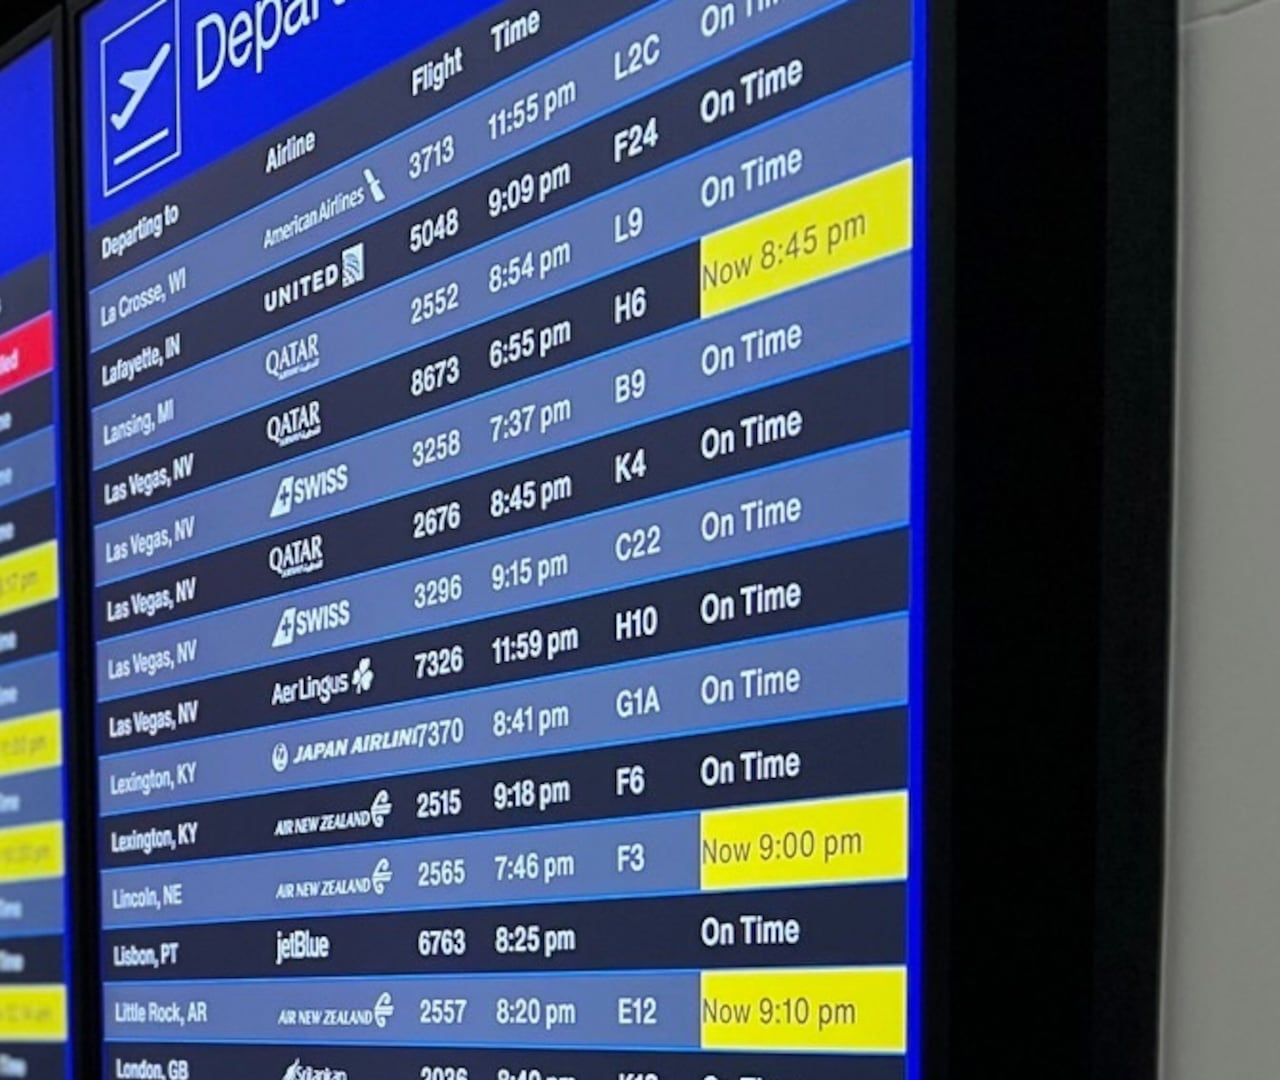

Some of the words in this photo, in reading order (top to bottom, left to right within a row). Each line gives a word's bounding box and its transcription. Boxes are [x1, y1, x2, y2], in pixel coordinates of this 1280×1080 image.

[489, 9, 541, 53] Time
[700, 2, 736, 39] On
[411, 45, 464, 98] Flight
[613, 32, 661, 82] L2C
[487, 91, 540, 141] 11:55
[543, 80, 577, 122] pm
[699, 88, 736, 124] On
[739, 58, 804, 106] Time
[264, 130, 317, 174] Airline
[408, 134, 455, 180] 3713
[613, 116, 659, 164] F24
[487, 172, 535, 218] 9:09
[538, 162, 572, 204] pm
[100, 212, 164, 261] Departing
[163, 203, 180, 227] to
[409, 206, 460, 253] 5048
[701, 254, 754, 292] Now
[759, 223, 819, 271] 8:45
[827, 213, 866, 256] pm
[100, 305, 118, 328] La
[117, 282, 167, 319] Crosse,
[167, 266, 187, 295] WI
[263, 262, 340, 313] UNITED
[614, 285, 647, 325] H6
[100, 345, 165, 388] Lafayette,
[164, 331, 182, 360] IN
[488, 327, 536, 369] 6:55
[539, 319, 572, 359] pm
[700, 343, 735, 377] On
[739, 323, 803, 363] Time
[410, 354, 461, 397] 8673
[614, 367, 646, 404] B9
[265, 399, 321, 439] QATAR
[489, 403, 537, 443] 7:37
[539, 398, 572, 435] pm
[411, 428, 461, 468] 3258
[103, 481, 129, 506] Las
[127, 466, 173, 498] Vegas,
[172, 451, 195, 482] NV
[293, 463, 349, 505] SWISS
[104, 541, 130, 564] Las
[129, 528, 174, 558] Vegas,
[173, 514, 196, 543] NV
[615, 604, 659, 641] H10
[699, 592, 736, 625] On
[739, 582, 802, 616] Time
[413, 644, 465, 680] 7326
[490, 628, 544, 665] 11:59
[546, 626, 579, 661] pm
[270, 681, 300, 707] Aer
[297, 672, 350, 705] Lingus
[108, 716, 134, 739] Las
[131, 708, 178, 737] Vegas,
[176, 698, 200, 726] NV
[617, 842, 646, 872] F3
[701, 838, 752, 865] Now
[758, 828, 816, 862] 9:00
[823, 831, 862, 865] pm
[274, 882, 296, 900] AIR
[294, 881, 322, 899] NEW
[319, 876, 372, 897] ZEALAND
[417, 858, 466, 887] 2565
[493, 851, 540, 881] 7:46
[543, 854, 575, 885] pm
[111, 885, 163, 911] Lincoln,
[162, 882, 184, 907] NE
[274, 929, 331, 966] jetBlue
[417, 927, 467, 957] 6763
[494, 924, 541, 954] 8:25
[543, 929, 576, 958] pm
[700, 916, 735, 947] On
[738, 914, 801, 945] Time
[112, 944, 160, 969] Lisbon,
[159, 941, 180, 965] PT
